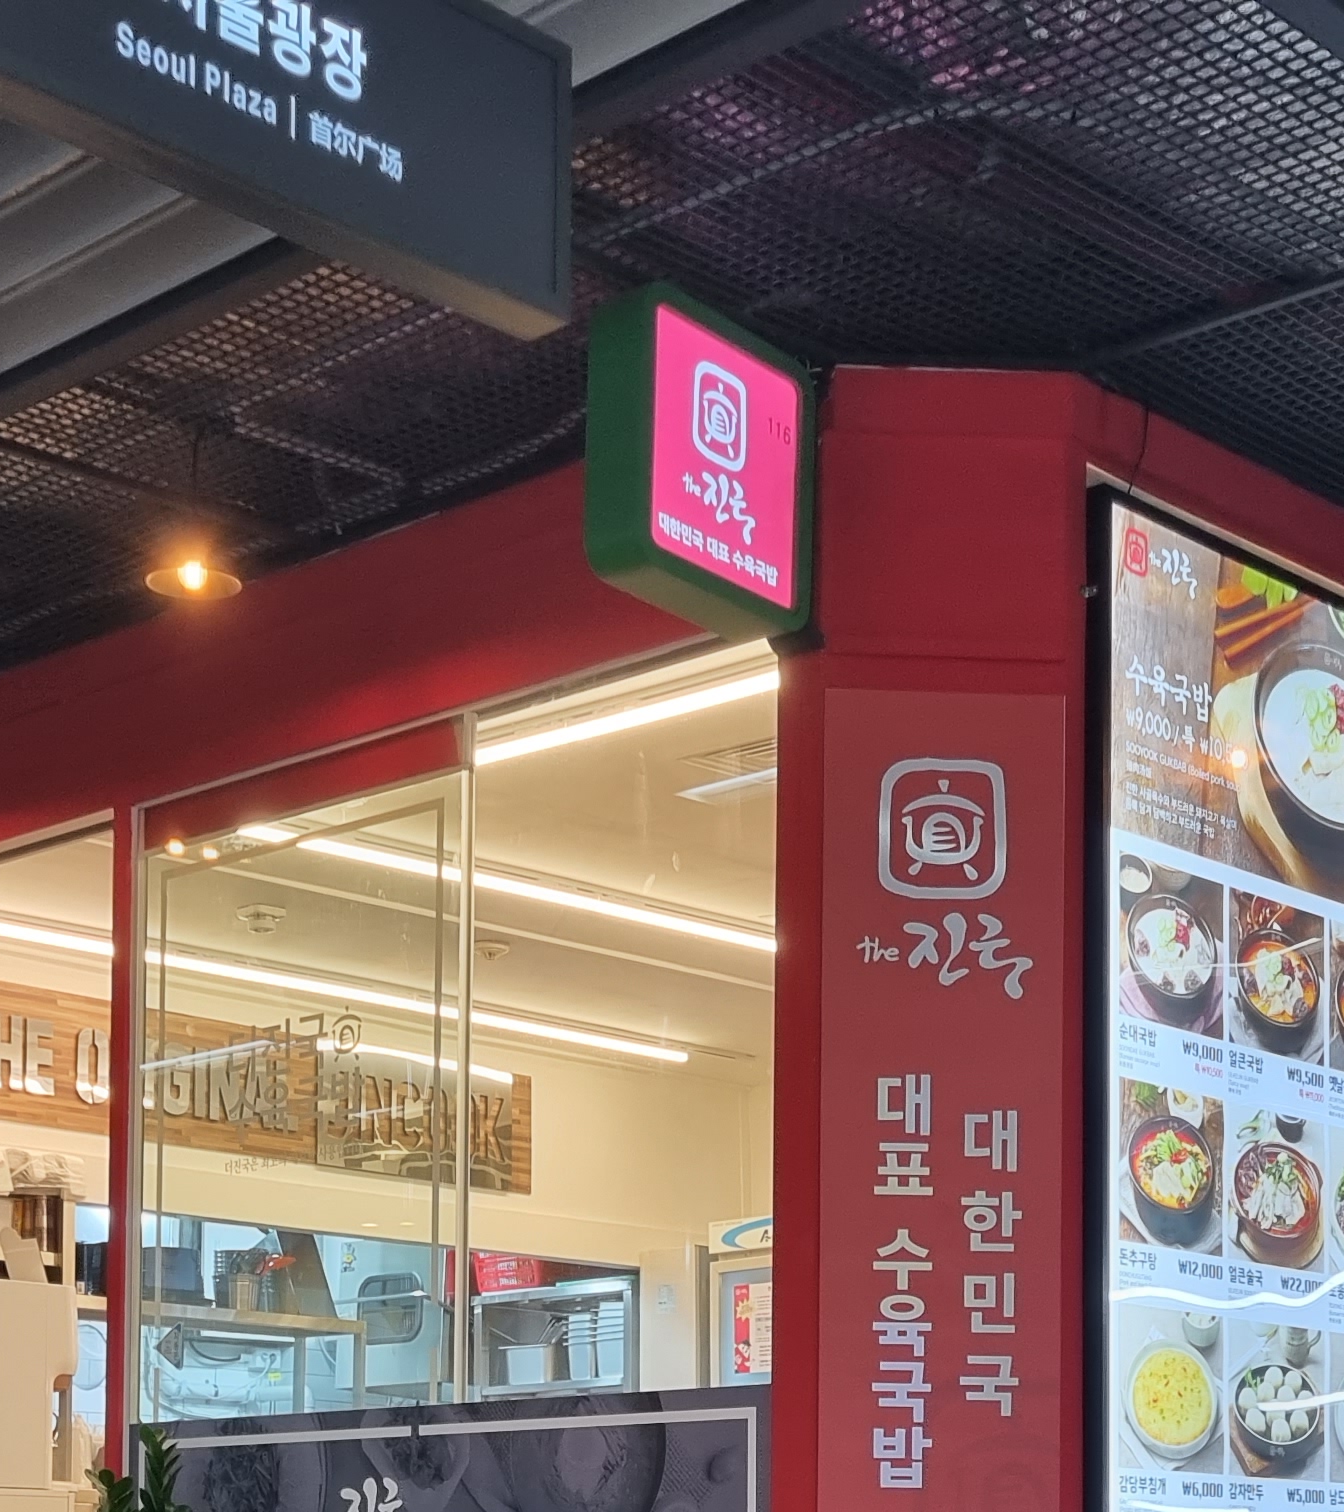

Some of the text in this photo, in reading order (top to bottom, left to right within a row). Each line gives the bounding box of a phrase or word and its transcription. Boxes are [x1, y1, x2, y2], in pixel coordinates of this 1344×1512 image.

[115, 20, 278, 127] Seoul Plaza
[308, 110, 405, 184] 首尔广场
[767, 417, 792, 446] 116
[682, 472, 702, 498] the
[658, 511, 778, 587] 대한민국 대표 수육국밥
[1125, 654, 1213, 724] 수육국밥
[1126, 707, 1196, 753] ₩9,000 특
[1125, 740, 1160, 763] SOOYOOK
[1159, 753, 1188, 773] GUKBAB
[1210, 775, 1226, 789] pork
[1195, 807, 1220, 824] 돼지고기
[856, 912, 1033, 1000] the 진국
[1119, 1022, 1157, 1048] 순대국밥
[1182, 1039, 1223, 1064] ₩9,000
[74, 1026, 299, 1133] OIGINAL
[1228, 1049, 1264, 1074] 얼큰국밥
[1286, 1065, 1324, 1089] ₩9,500
[871, 1073, 934, 1489] 대표 수육국밥
[959, 1109, 1023, 1417] 대한민국
[1119, 1247, 1157, 1271] 돈추구탕
[1178, 1258, 1223, 1281] ₩12,000
[1228, 1264, 1264, 1288] 얼큰술국
[1280, 1275, 1324, 1296] ₩22,00
[1119, 1475, 1223, 1501] 감당부침개 ₩6,000
[1228, 1482, 1325, 1507] 감자만두 ₩5,000
